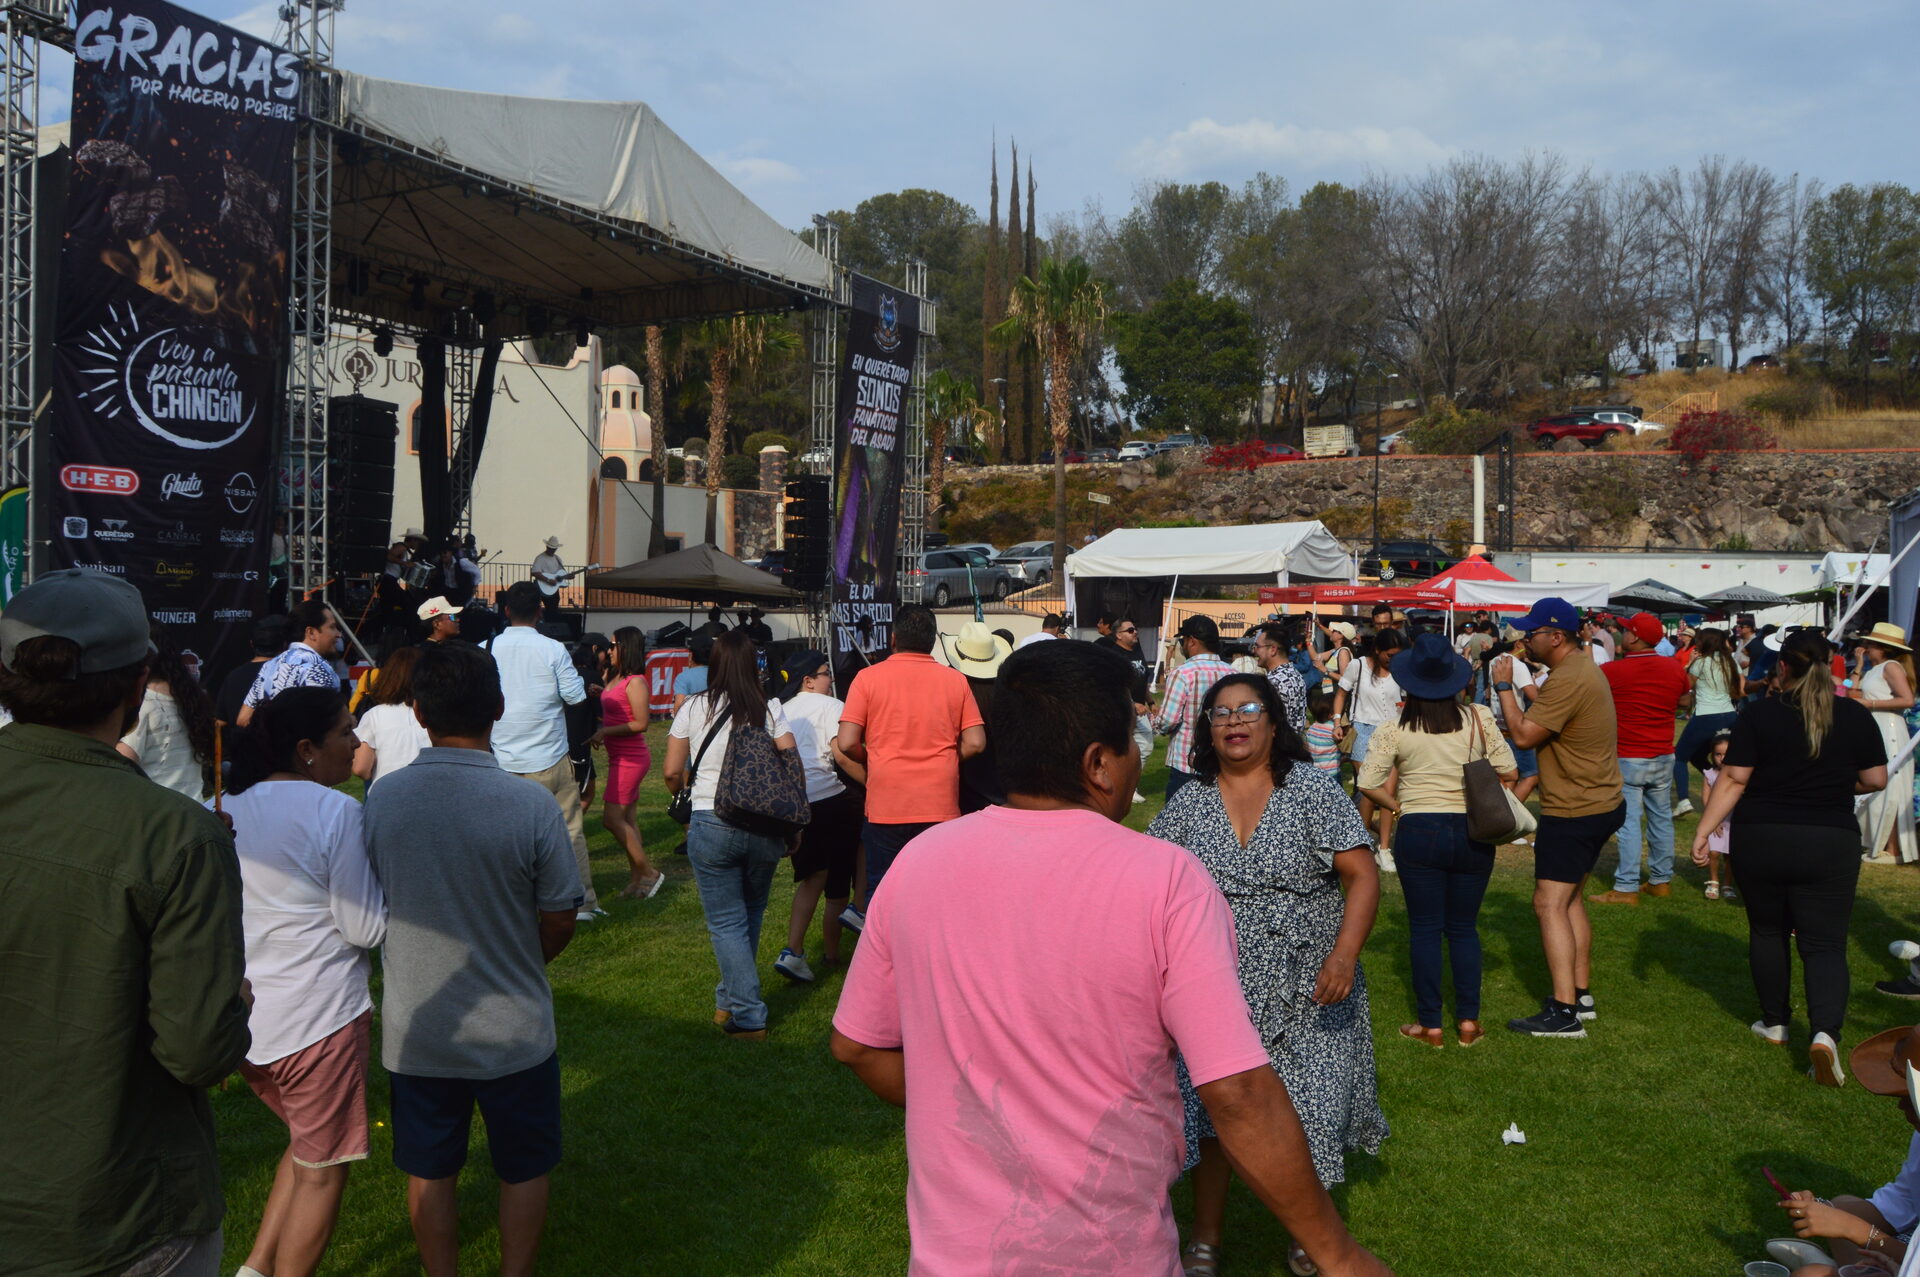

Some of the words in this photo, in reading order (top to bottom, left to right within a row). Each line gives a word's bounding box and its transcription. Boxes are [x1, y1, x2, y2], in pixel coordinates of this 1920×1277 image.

[130, 76, 163, 96] POR
[169, 83, 239, 110] HACERLO
[159, 334, 195, 368] Voy
[203, 347, 215, 362] a
[146, 363, 238, 393] pasarla
[852, 354, 864, 371] EN
[865, 359, 910, 384] QUERÉTARO
[856, 375, 902, 414] SOMOS
[853, 406, 898, 433] FANÁTICOS
[850, 428, 868, 446] DEL
[869, 431, 896, 452] ASADO
[224, 488, 257, 497] NISSAN
[1323, 589, 1356, 597] NISSAN
[1224, 612, 1246, 620] ACCESO
